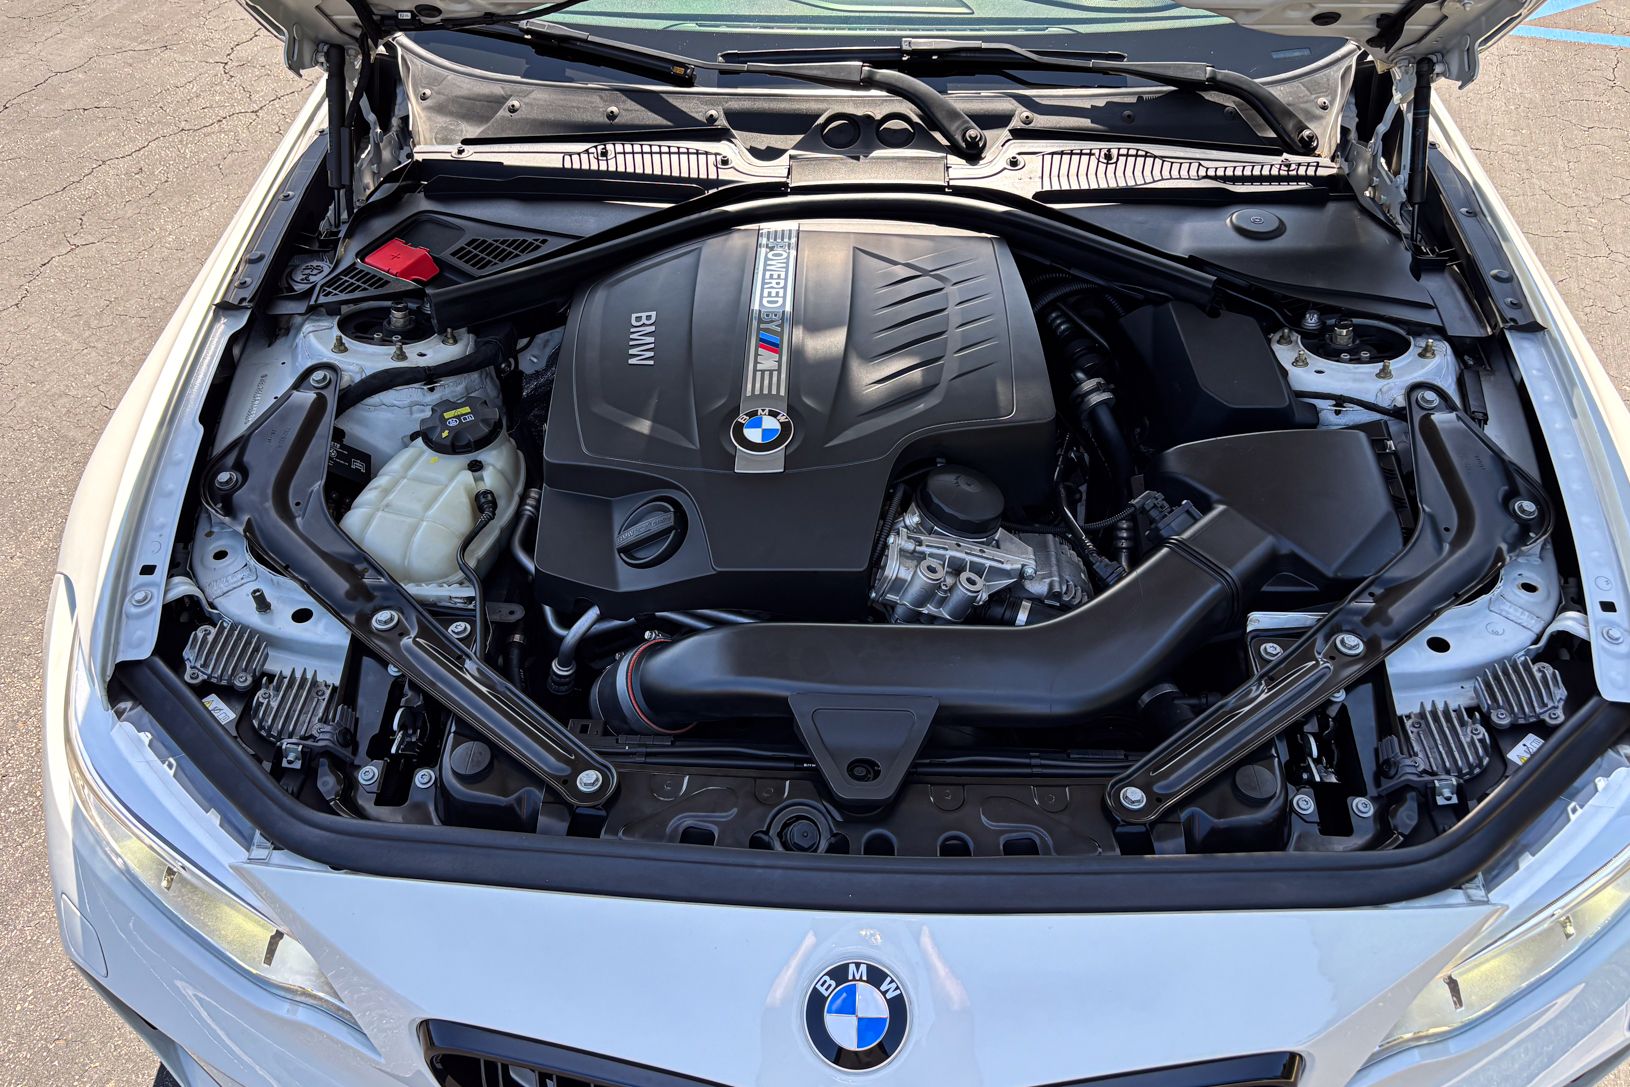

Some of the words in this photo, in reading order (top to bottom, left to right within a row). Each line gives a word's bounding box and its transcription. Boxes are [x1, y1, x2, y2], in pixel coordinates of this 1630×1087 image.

[762, 240, 788, 308] POWERED
[628, 311, 657, 365] BMW
[760, 309, 783, 332] BY
[738, 408, 789, 424] BMW
[815, 963, 901, 1000] BMW
